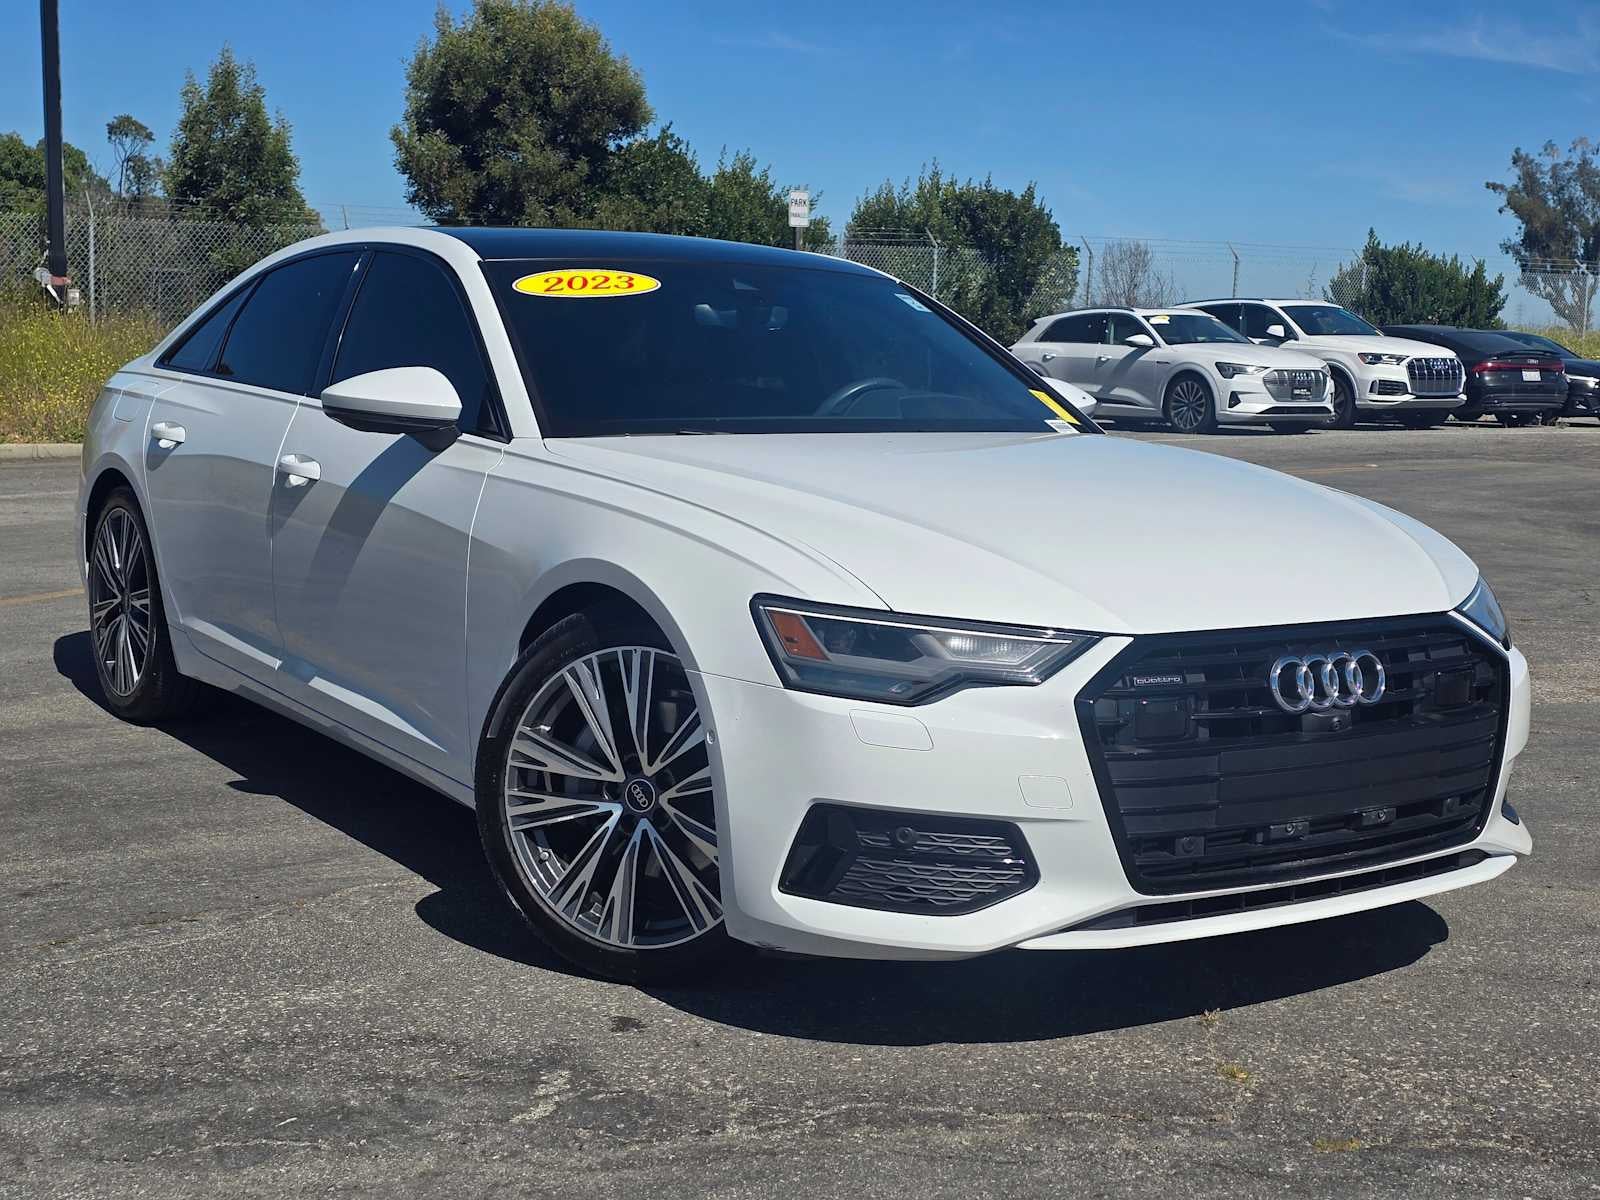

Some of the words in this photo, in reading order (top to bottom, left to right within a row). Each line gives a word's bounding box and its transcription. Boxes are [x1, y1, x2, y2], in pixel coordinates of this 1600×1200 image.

[791, 199, 807, 207] PARK
[543, 275, 635, 293] 2023
[1136, 676, 1181, 684] quattro
